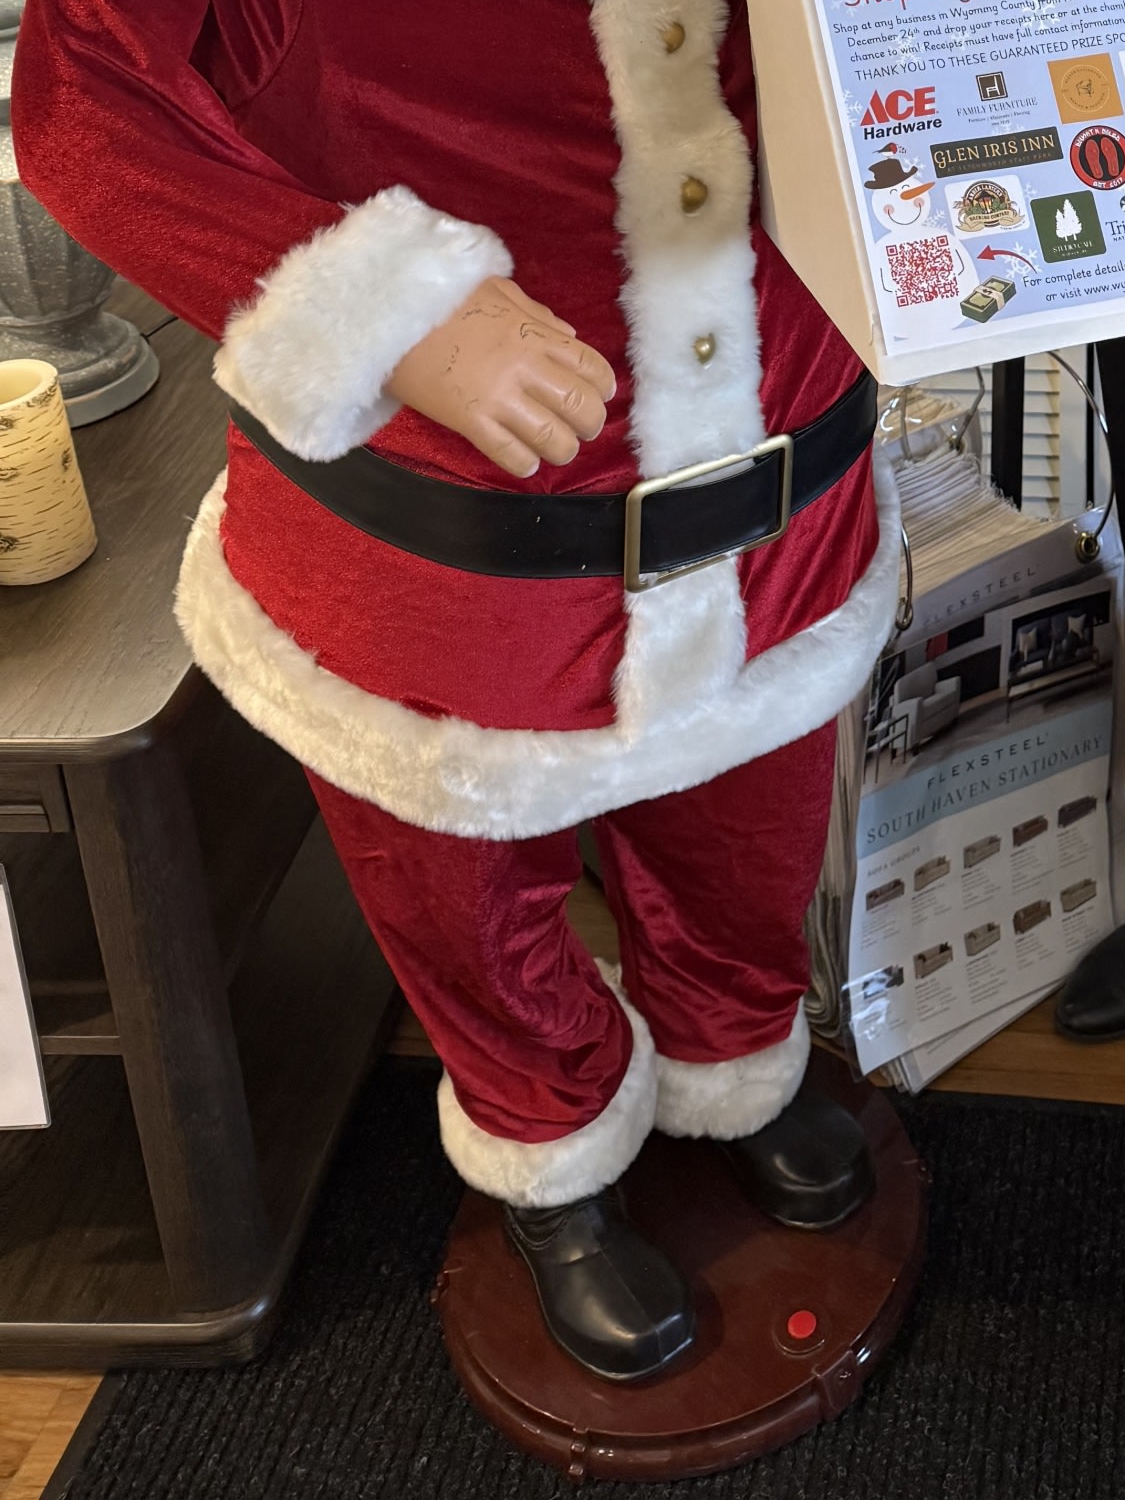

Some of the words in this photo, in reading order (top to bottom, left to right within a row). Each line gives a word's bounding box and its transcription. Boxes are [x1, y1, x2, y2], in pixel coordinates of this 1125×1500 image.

[833, 23, 859, 35] Shop
[861, 21, 872, 30] at
[874, 19, 894, 30] any
[896, 13, 937, 25] business
[938, 10, 949, 19] in
[949, 4, 998, 21] Wyoming
[1000, 0, 1036, 11] County
[847, 33, 899, 47] December
[900, 28, 920, 39] 24th
[923, 26, 942, 37] and
[944, 21, 967, 37] drop
[969, 21, 992, 34] your
[994, 13, 1032, 28] receipts
[1034, 11, 1055, 22] here
[1057, 10, 1068, 18] or
[1071, 7, 1081, 16] at
[1083, 5, 1098, 14] the
[850, 51, 885, 63] chance
[888, 47, 898, 56] to
[900, 42, 921, 54] win!
[923, 38, 963, 52] Receipts
[965, 35, 990, 46] must
[992, 31, 1014, 43] have
[1016, 27, 1032, 41] full
[1034, 24, 1069, 36] contact
[1071, 18, 1125, 34] information
[855, 65, 899, 81] THANK
[900, 60, 927, 74] YOU
[928, 58, 946, 69] TO
[948, 53, 987, 68] THESE
[989, 41, 1069, 61] GUARANTEED
[1071, 36, 1103, 50] PRIZE
[860, 86, 936, 126] ACE
[956, 105, 987, 117] FAMILY
[988, 97, 1038, 113] FURNITURE
[864, 118, 943, 140] Hardware
[933, 145, 980, 169] GLEN
[983, 140, 1018, 158] IRIS
[1021, 133, 1056, 152] INN
[1022, 275, 1043, 288] For
[1045, 269, 1092, 289] complete
[1046, 292, 1058, 301] or
[1060, 285, 1083, 299] visit
[927, 735, 1046, 790] FLEXSTEEL
[867, 805, 926, 844] SOUTH
[931, 779, 991, 813] HAVEN
[999, 735, 1102, 786] STATIONARY
